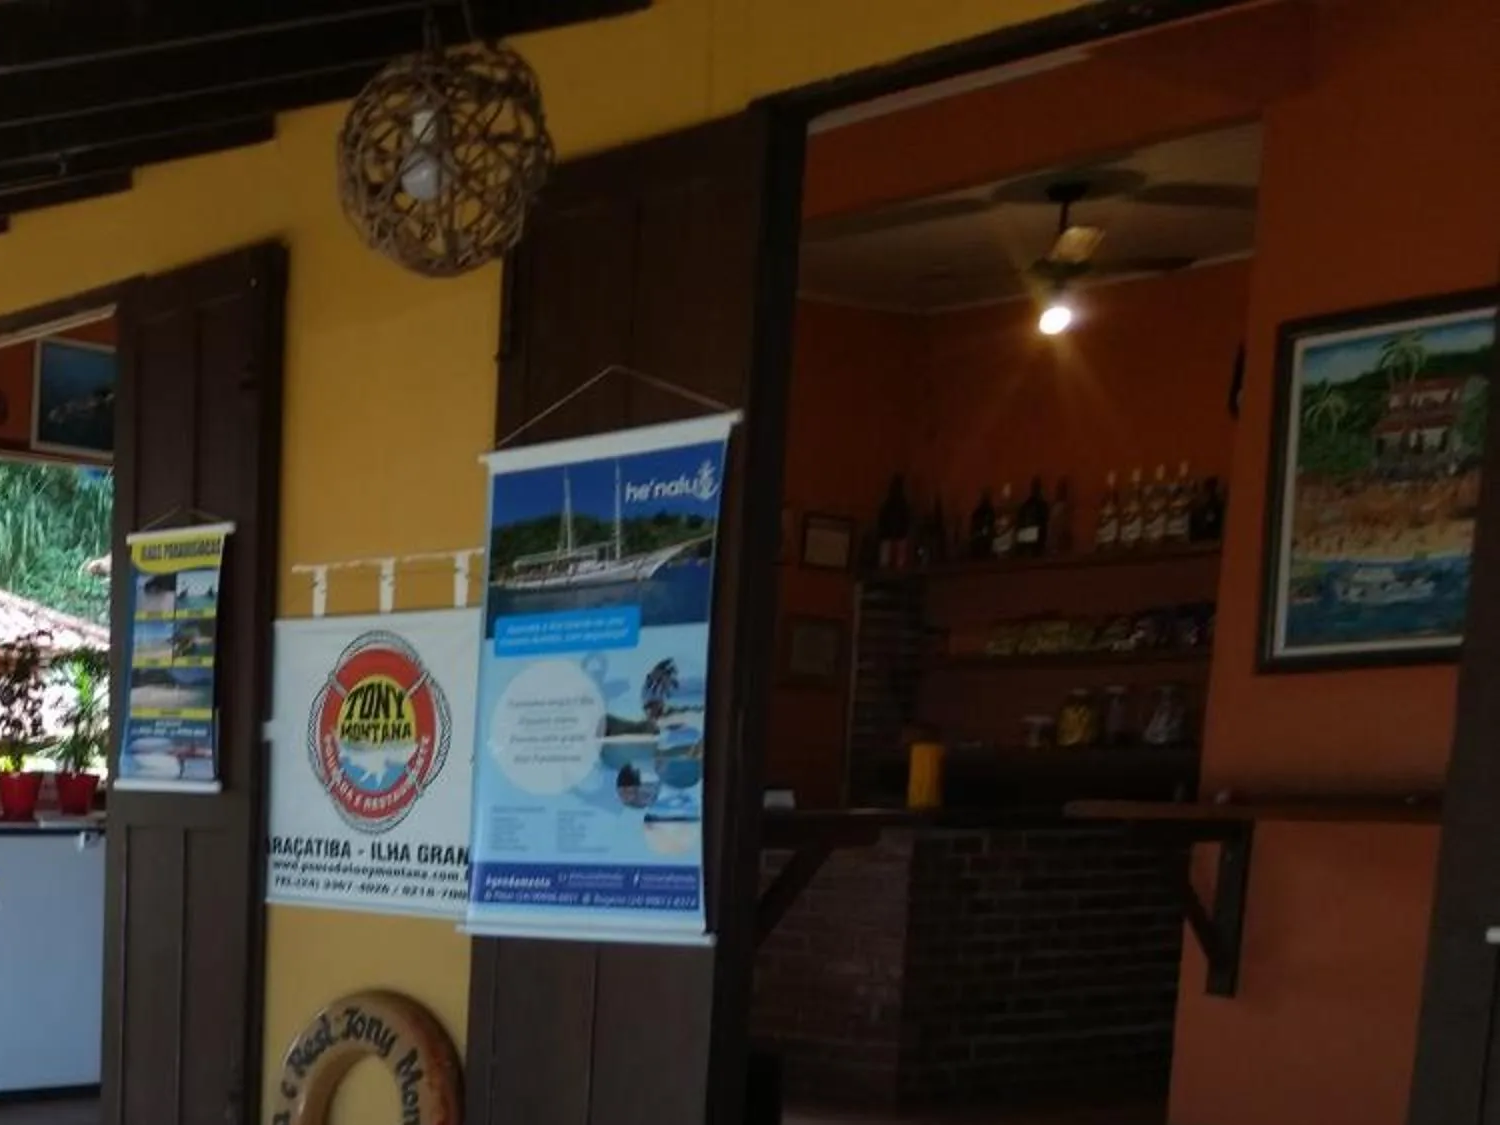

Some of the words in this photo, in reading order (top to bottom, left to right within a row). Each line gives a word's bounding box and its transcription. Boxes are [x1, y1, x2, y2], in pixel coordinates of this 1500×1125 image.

[344, 682, 405, 721] TONY
[341, 721, 412, 743] MONTANA
[371, 841, 411, 862] ILHA
[341, 1006, 397, 1057] Tony
